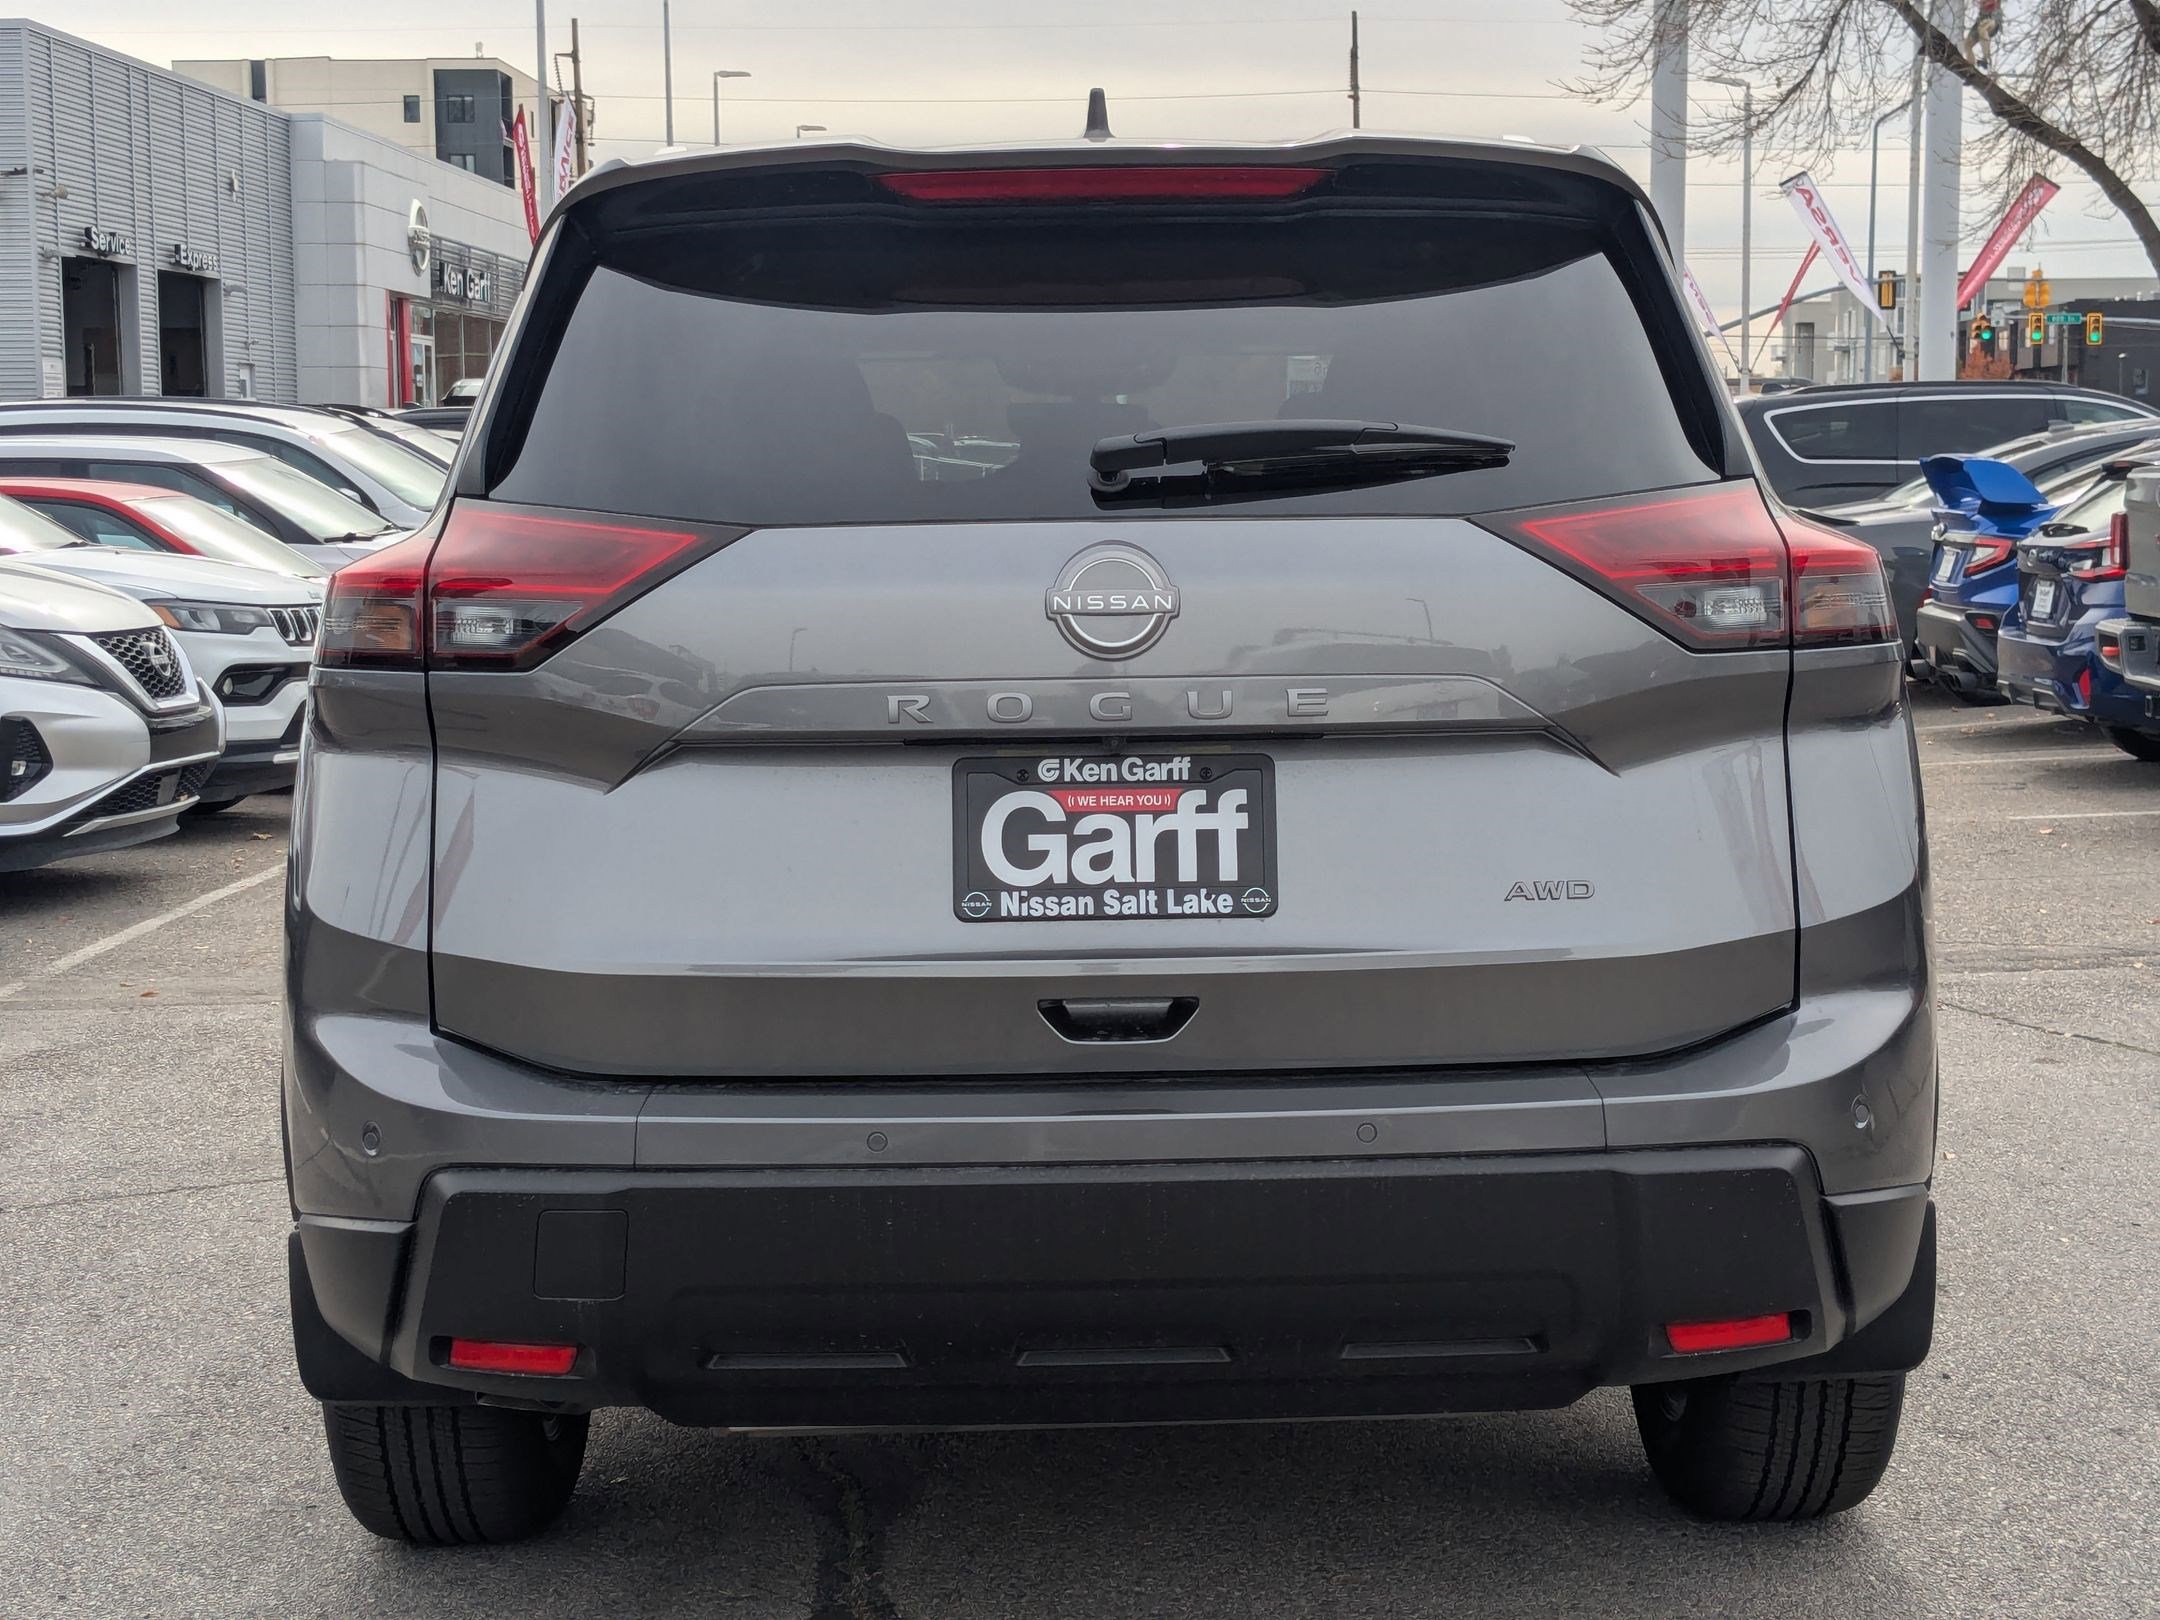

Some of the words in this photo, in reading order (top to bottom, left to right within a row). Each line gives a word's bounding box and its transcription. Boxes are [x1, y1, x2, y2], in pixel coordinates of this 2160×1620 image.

[90, 225, 133, 256] Service
[179, 243, 219, 272] Express
[443, 261, 464, 297] Ken
[1053, 594, 1173, 611] NISSAN
[886, 687, 1330, 725] ROGUE
[1063, 757, 1118, 783] Ken
[1121, 756, 1192, 782] Garff
[1076, 796, 1097, 807] WE
[1100, 795, 1134, 806] HEAR
[1136, 794, 1162, 806] YOU
[982, 788, 1249, 887] Garff
[1000, 890, 1095, 917] Nissan
[1103, 888, 1158, 916] Salt
[1167, 887, 1234, 914] Lake
[1503, 879, 1596, 902] AWD
